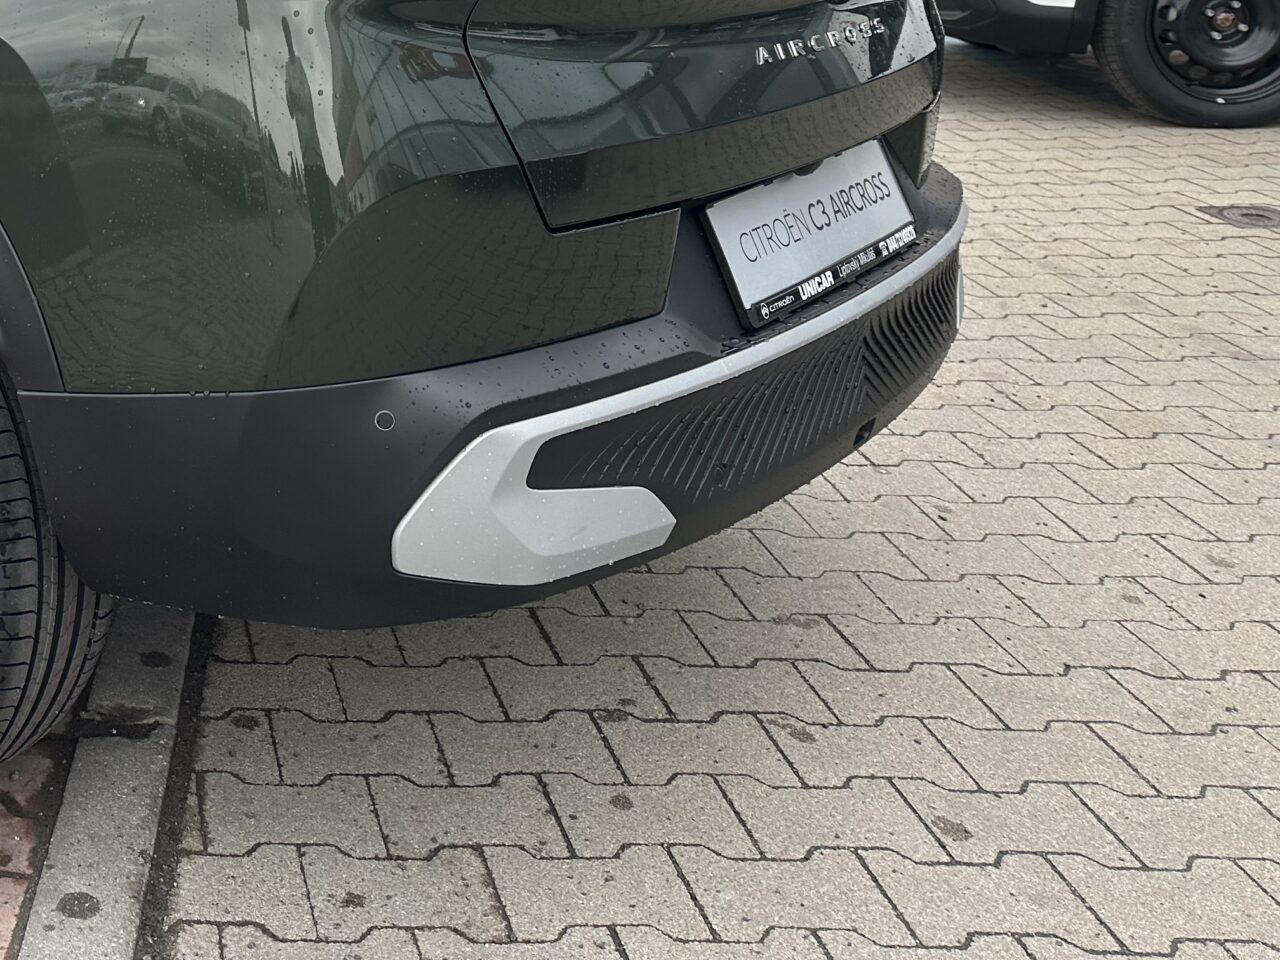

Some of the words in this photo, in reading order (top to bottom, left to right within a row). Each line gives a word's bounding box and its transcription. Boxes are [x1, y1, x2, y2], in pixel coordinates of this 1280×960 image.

[755, 17, 885, 65] AIRCROSS
[739, 208, 812, 263] CITROËN
[808, 199, 832, 231] C3
[830, 171, 891, 223] AIRCROSS
[798, 270, 835, 301] UNICAR
